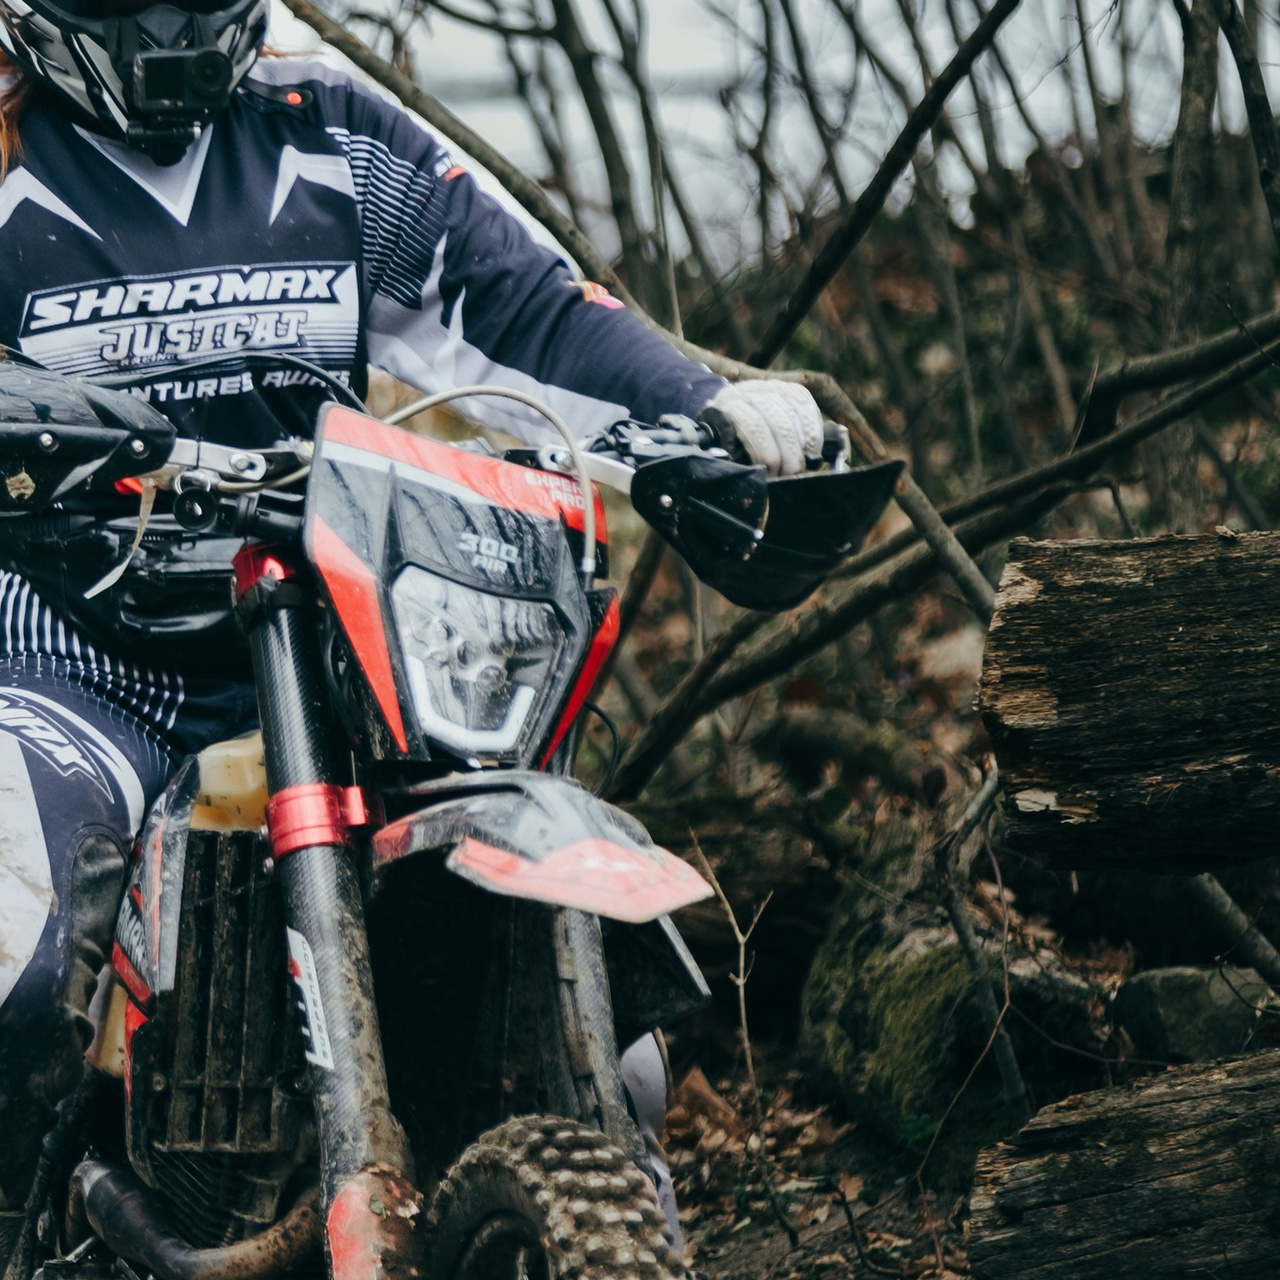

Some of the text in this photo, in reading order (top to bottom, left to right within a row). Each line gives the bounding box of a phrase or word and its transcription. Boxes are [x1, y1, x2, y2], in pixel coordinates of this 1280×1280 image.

[29, 268, 337, 331] SHARMAX
[120, 372, 253, 402] NTURES
[524, 471, 584, 495] EXPER
[458, 532, 519, 564] 300
[472, 554, 509, 574] AIR
